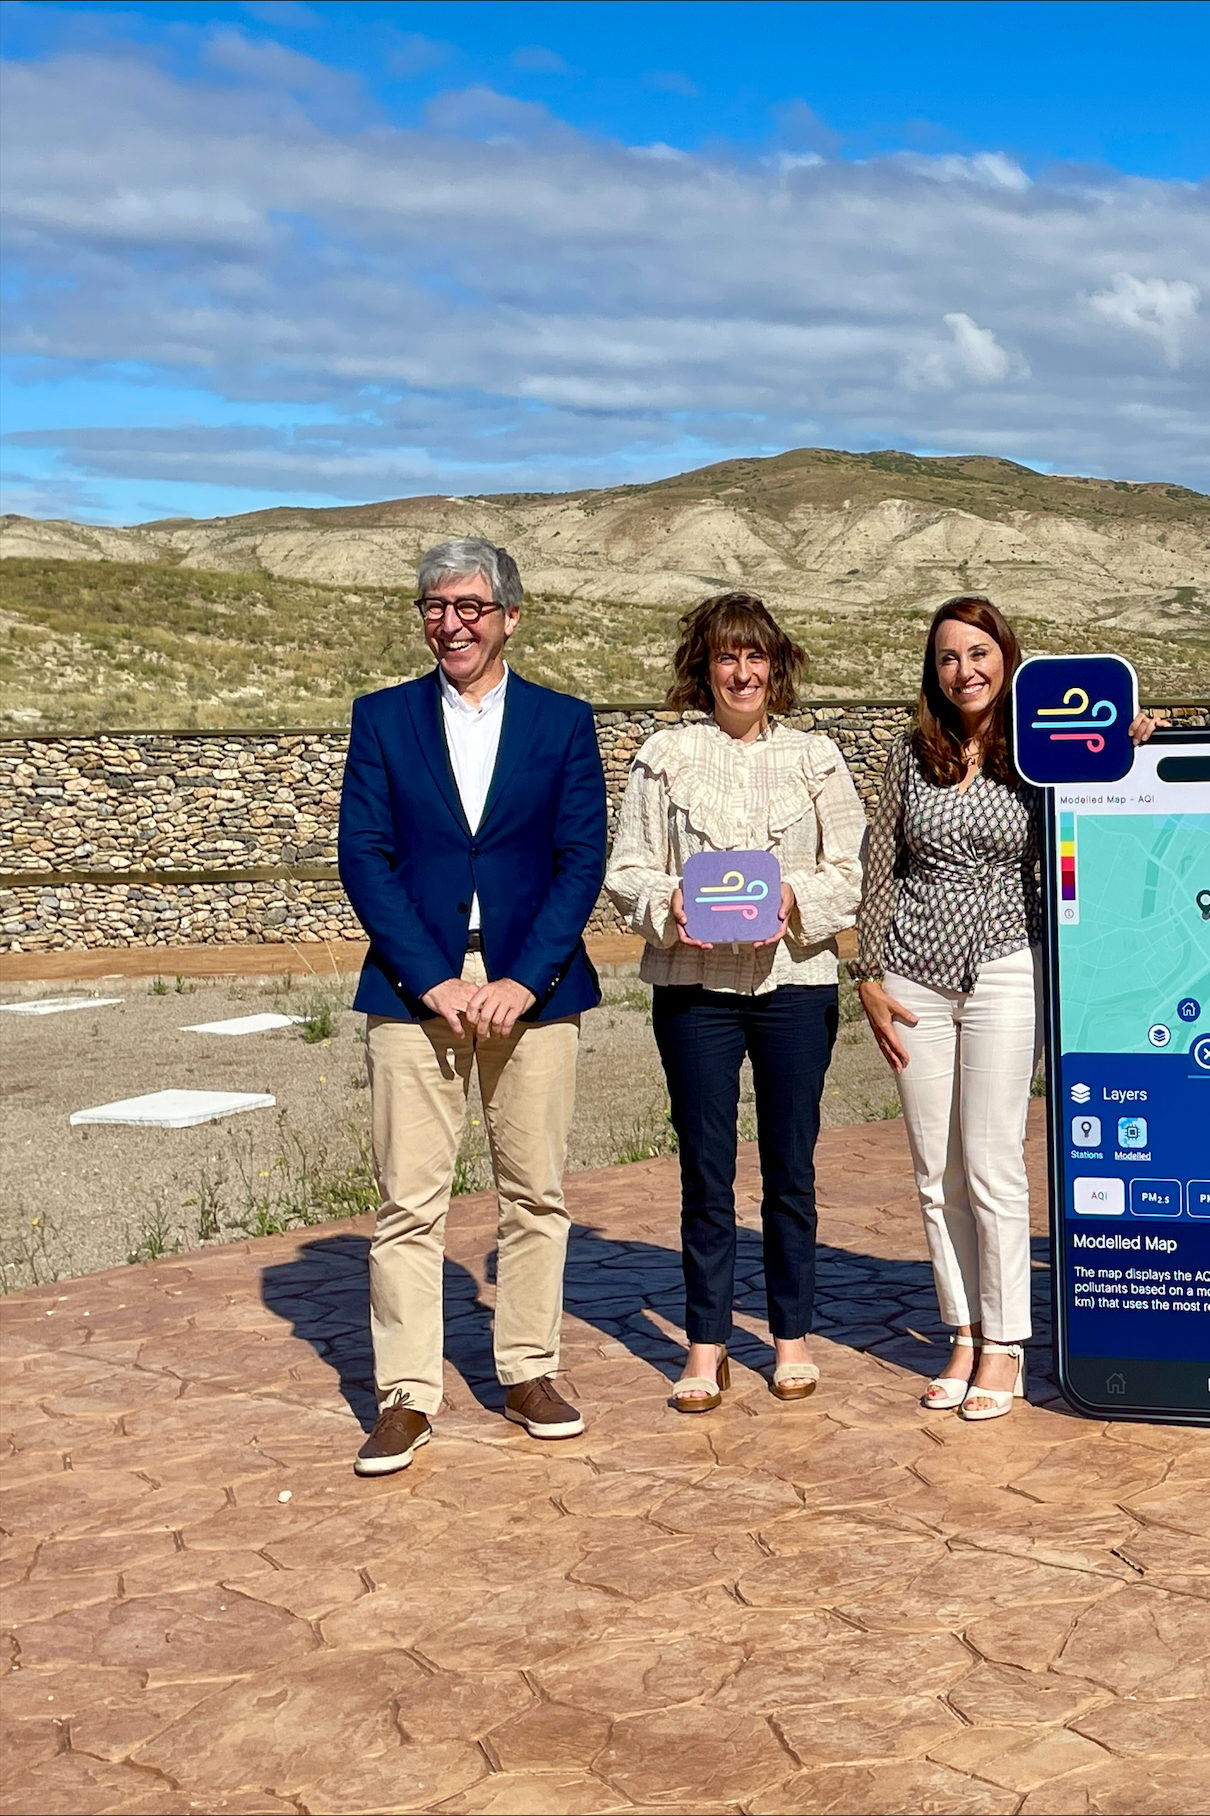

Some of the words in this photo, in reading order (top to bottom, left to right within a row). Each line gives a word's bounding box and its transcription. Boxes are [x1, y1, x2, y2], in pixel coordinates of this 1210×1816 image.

[1060, 796, 1103, 804] Modelled
[1107, 795, 1126, 805] Map
[1138, 795, 1154, 803] AQI
[1103, 1087, 1147, 1104] Layers
[1071, 1150, 1104, 1160] Stations
[1114, 1152, 1151, 1161] Modelled
[1091, 1192, 1108, 1201] AQI
[1073, 1234, 1141, 1250] Modelled
[1145, 1237, 1177, 1254] Map
[1074, 1267, 1095, 1278] The
[1098, 1270, 1122, 1281] map
[1125, 1269, 1171, 1282] displays
[1174, 1270, 1192, 1281] the
[1074, 1282, 1128, 1295] pollutants
[1131, 1284, 1166, 1296] based
[1169, 1287, 1184, 1296] on
[1187, 1288, 1194, 1296] a
[1074, 1297, 1095, 1309] km)
[1098, 1298, 1120, 1308] that
[1123, 1300, 1149, 1309] uses
[1151, 1300, 1170, 1310] the
[1173, 1301, 1201, 1312] most
